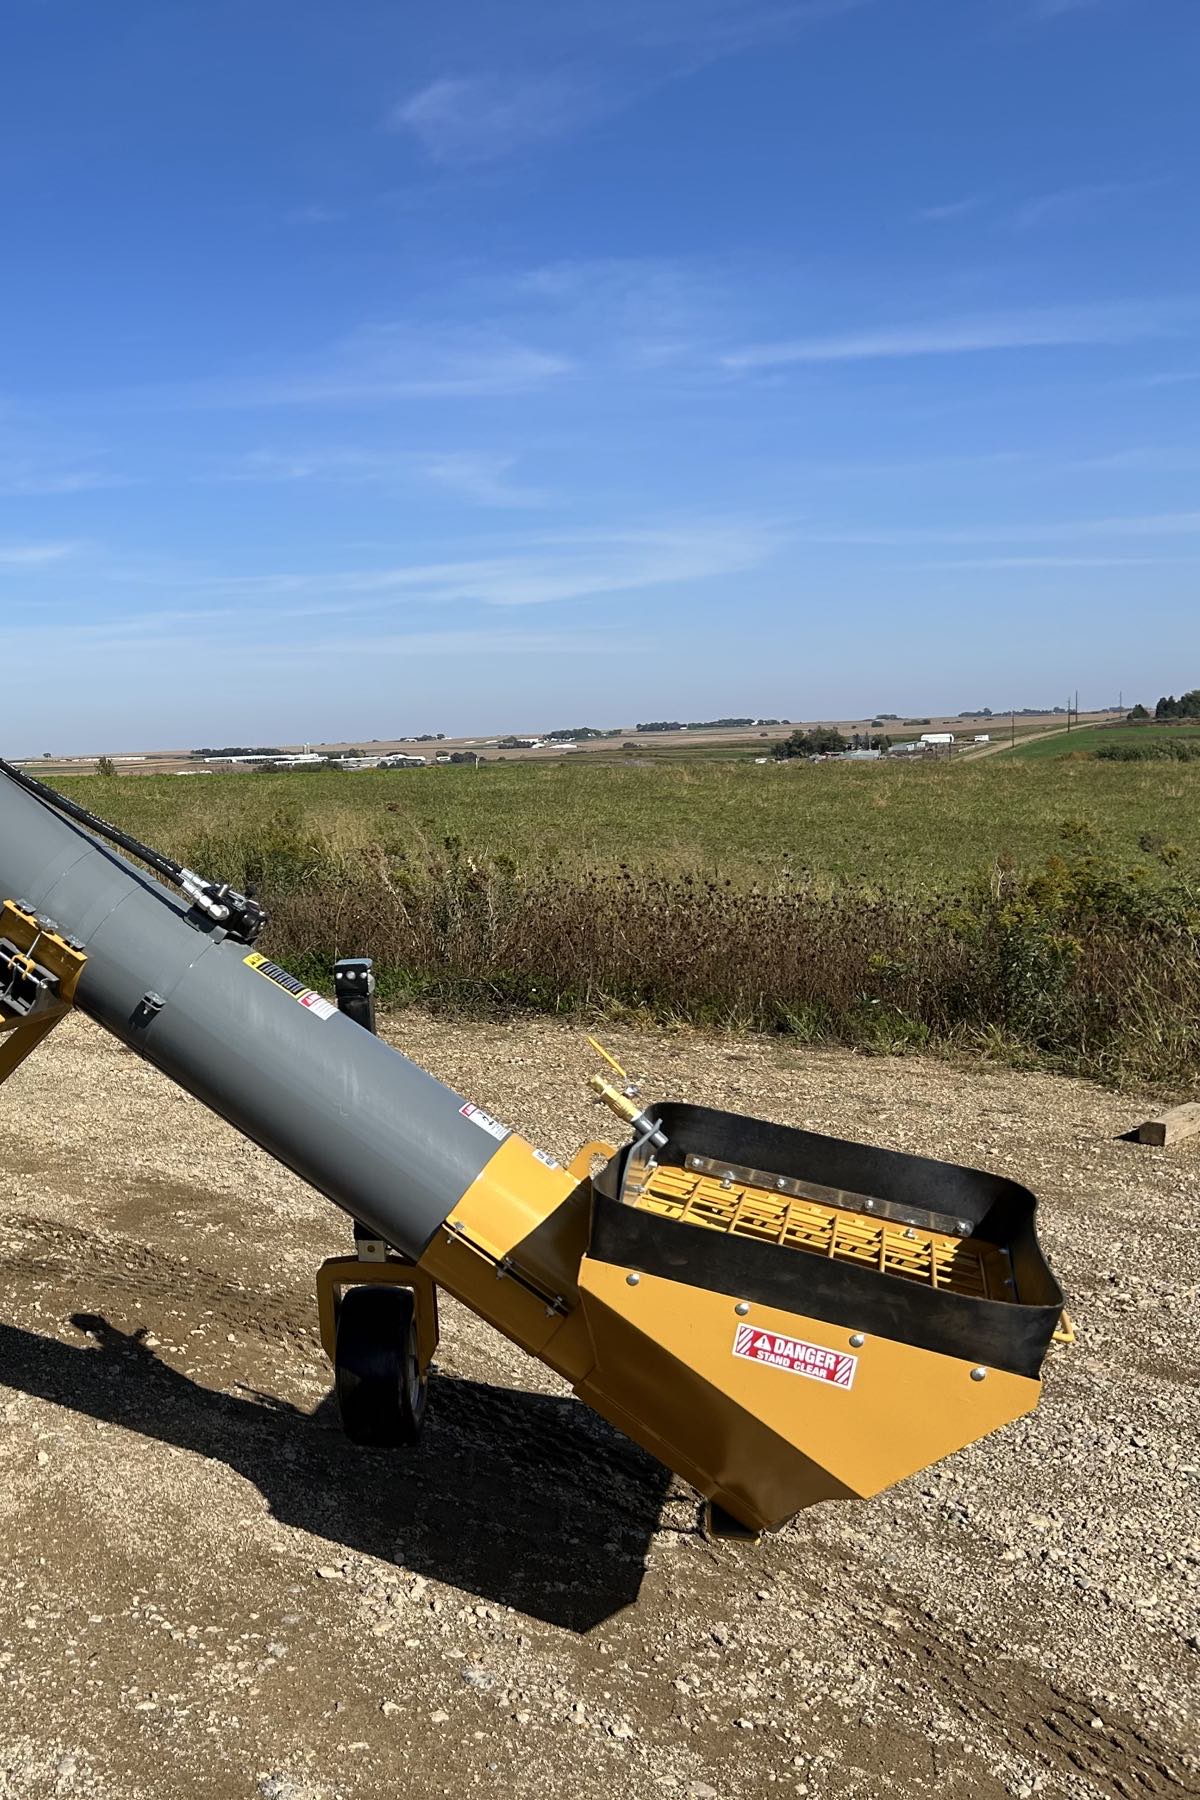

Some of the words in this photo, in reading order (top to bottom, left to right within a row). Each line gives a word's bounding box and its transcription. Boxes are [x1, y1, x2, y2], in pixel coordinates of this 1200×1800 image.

[756, 1349, 791, 1367] STAND
[793, 1361, 828, 1378] CLEAR
[773, 1337, 837, 1370] DANGER
